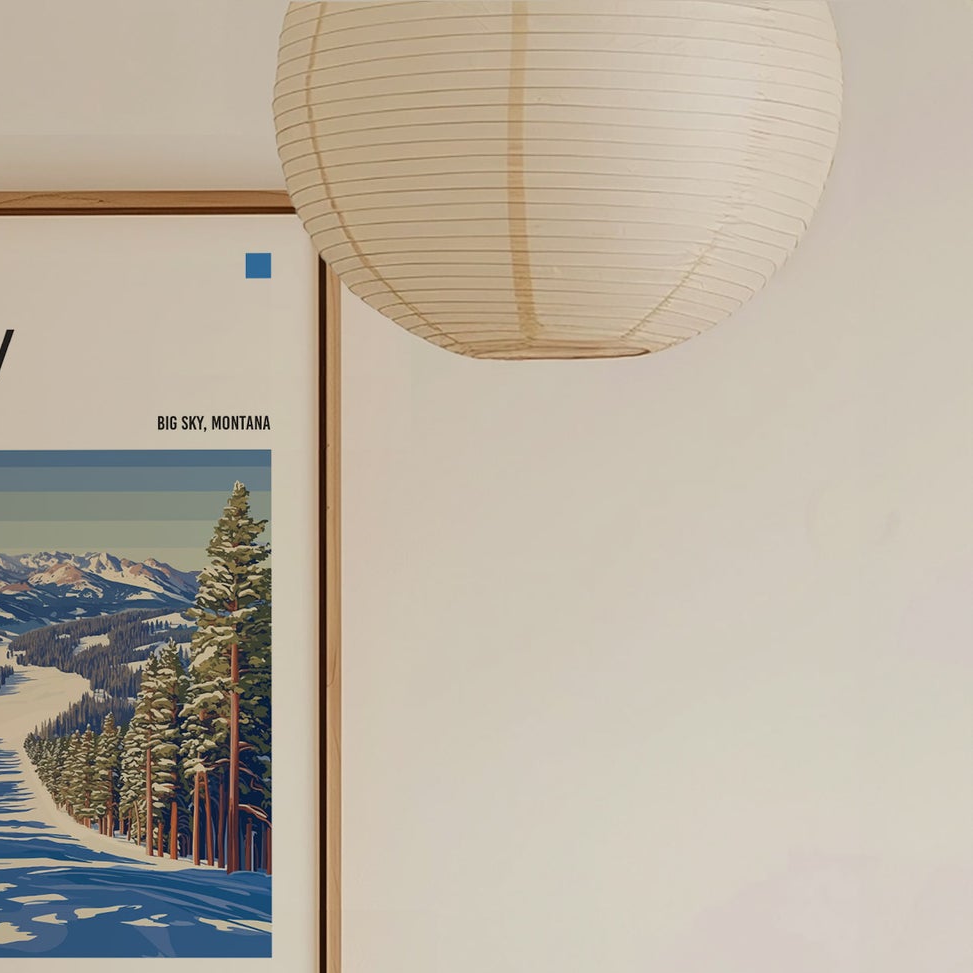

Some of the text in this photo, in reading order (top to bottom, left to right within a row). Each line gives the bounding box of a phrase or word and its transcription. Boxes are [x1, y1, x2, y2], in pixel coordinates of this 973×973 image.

[157, 415, 271, 433] BIG SKY, MONTANA
